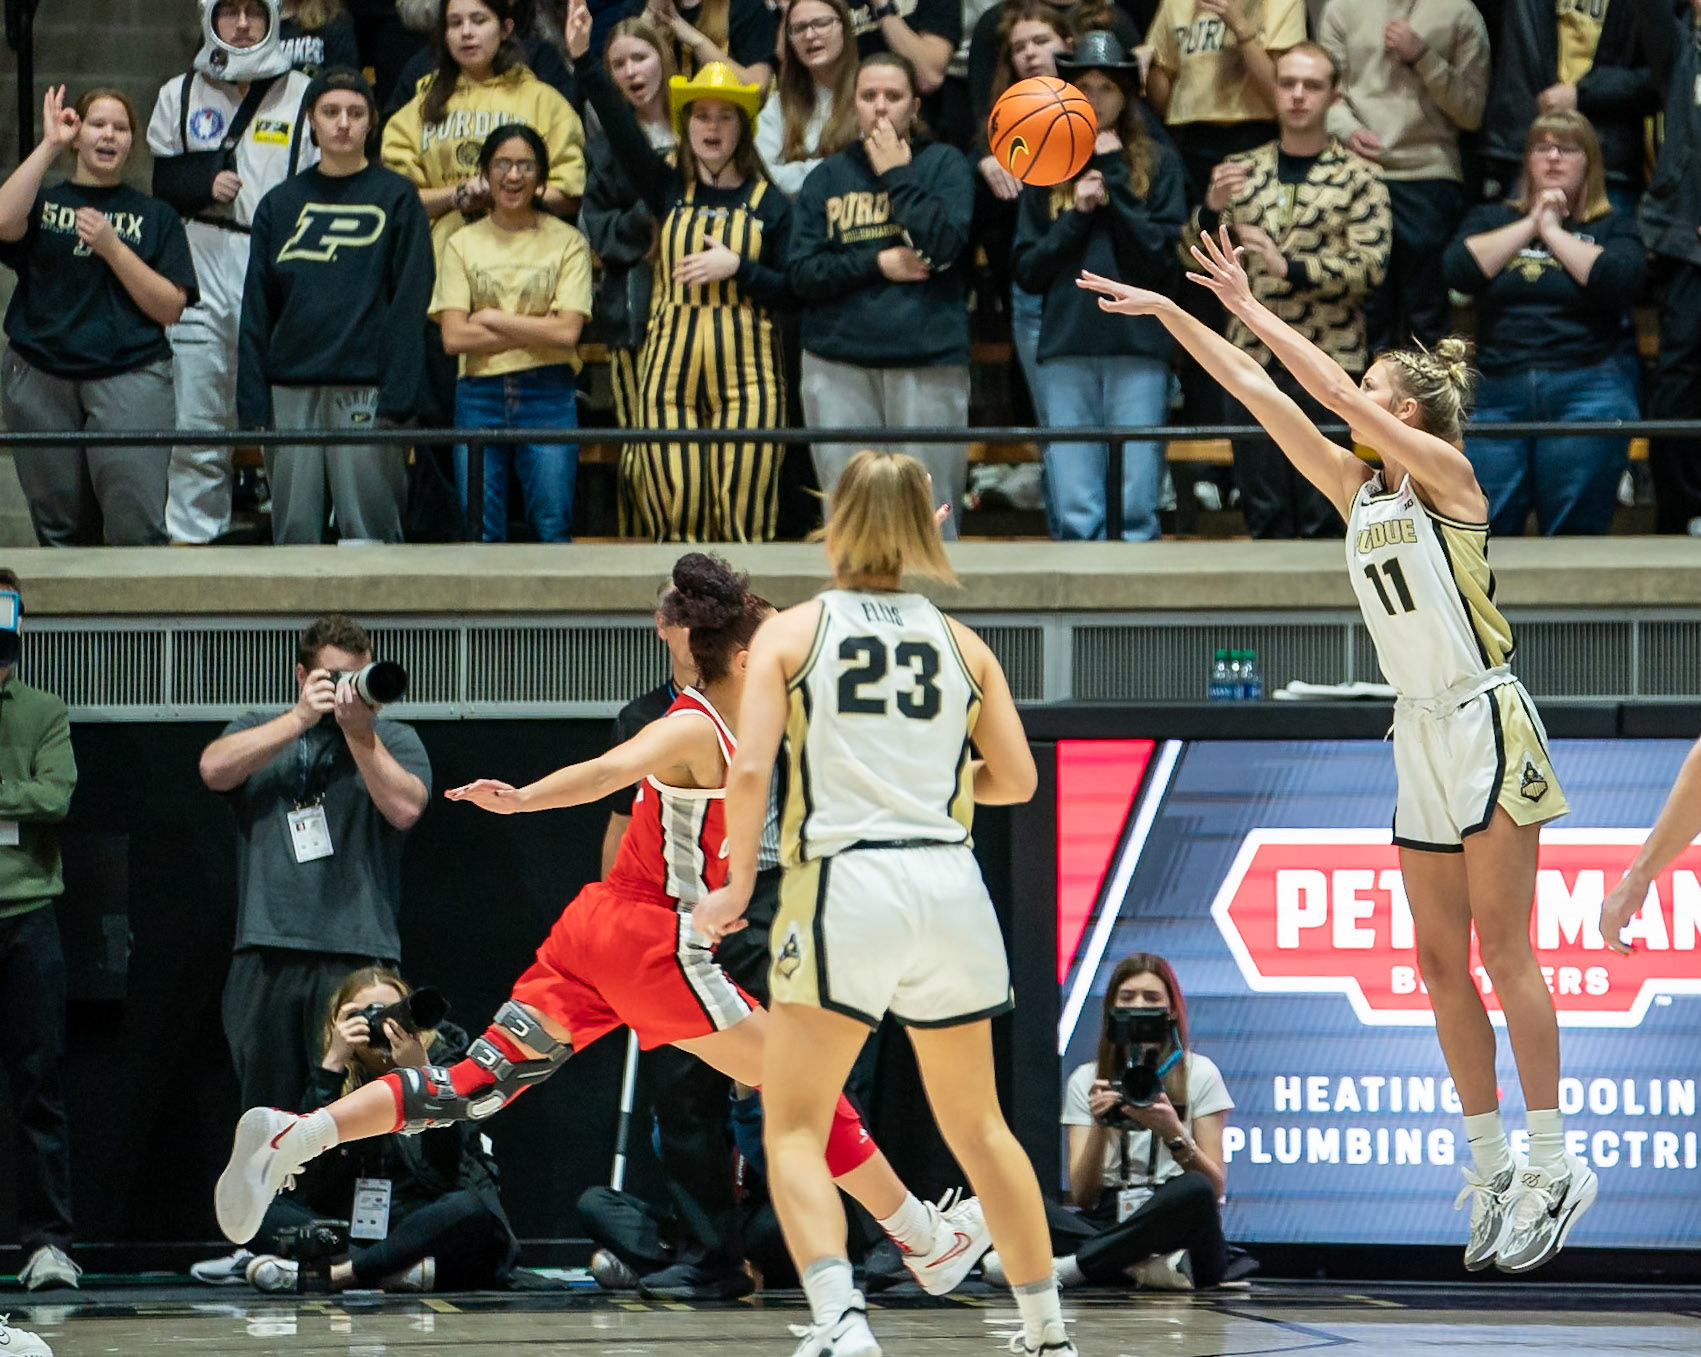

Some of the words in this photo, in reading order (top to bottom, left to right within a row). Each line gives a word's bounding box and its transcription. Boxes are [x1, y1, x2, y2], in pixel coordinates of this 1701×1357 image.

[422, 111, 528, 151] PURDU
[276, 202, 387, 263] P
[826, 191, 890, 240] PURD
[1363, 557, 1417, 616] 11
[861, 602, 904, 627] ELLIS
[838, 635, 943, 721] 23
[1275, 869, 1701, 950] PETMAN
[1273, 1076, 1463, 1114] HEATING
[1556, 1077, 1696, 1116] OOLIN
[1222, 1126, 1455, 1166] PLUMBING
[1510, 1128, 1697, 1170] EECTRI
